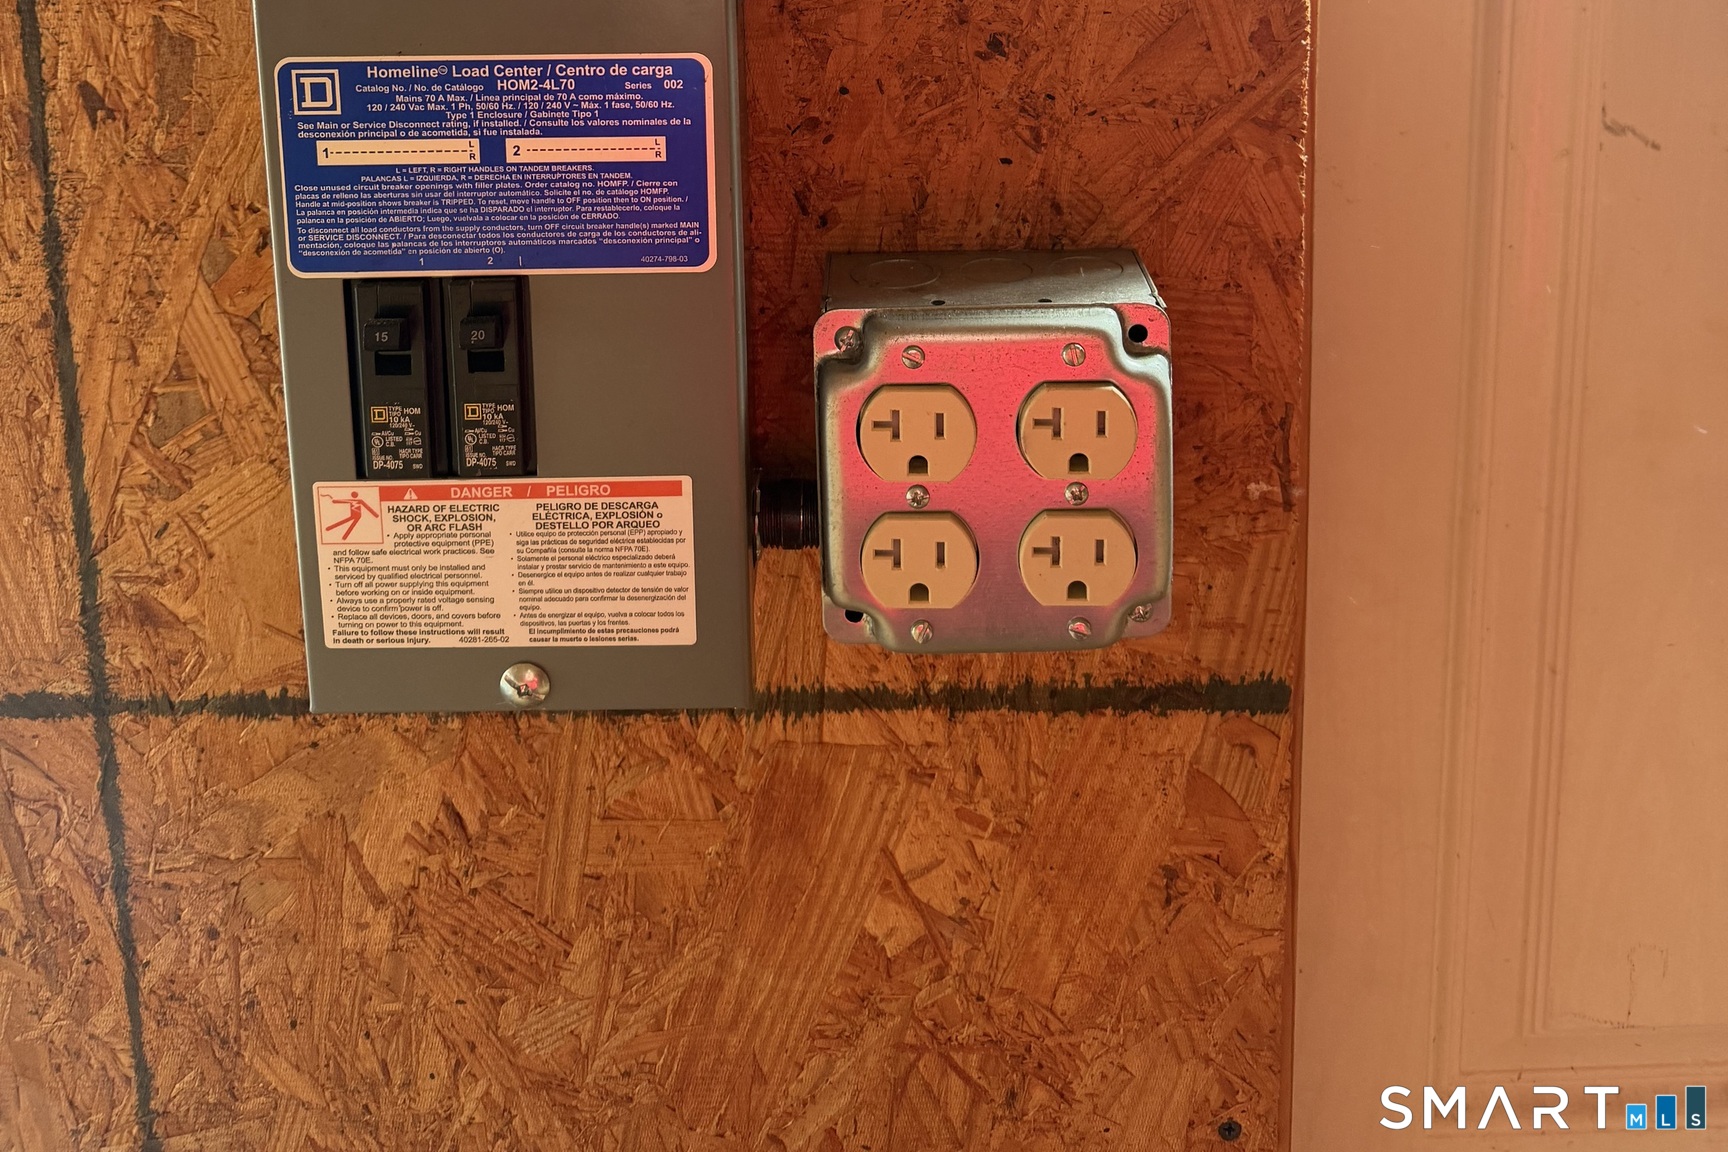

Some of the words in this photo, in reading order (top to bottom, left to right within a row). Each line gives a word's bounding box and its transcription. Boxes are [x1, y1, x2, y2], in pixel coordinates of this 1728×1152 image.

[451, 65, 489, 77] Load
[493, 64, 543, 76] Center
[546, 64, 551, 76] /
[554, 63, 605, 75] Centro
[609, 63, 627, 75] de
[631, 64, 672, 77] carga
[354, 84, 389, 93] Catalog
[391, 83, 407, 91] No.
[408, 83, 412, 91] /
[413, 83, 429, 91] No.
[430, 83, 442, 91] de
[444, 83, 484, 92] Catálogo
[496, 78, 575, 90] HOM2-4L70
[663, 78, 683, 88] 002
[395, 94, 422, 102] Mains
[446, 93, 467, 101] Max.
[470, 93, 473, 101] /
[502, 93, 541, 102] principal
[543, 92, 554, 100] de
[557, 92, 567, 100] 70
[569, 92, 576, 100] A
[605, 91, 642, 99] máximo.
[366, 103, 382, 111] 120
[389, 103, 406, 111] 240
[407, 102, 424, 110] Vac
[426, 102, 448, 110] Max.
[450, 102, 455, 110] 1
[458, 102, 473, 111] Ph,
[475, 102, 499, 110] 50/60
[501, 101, 515, 109] Hz.
[522, 101, 538, 109] 120
[545, 101, 562, 109] 240
[563, 101, 570, 109] V
[580, 100, 601, 108] Máx.
[604, 100, 608, 108] 1
[611, 100, 633, 109] fase,
[634, 100, 658, 108] 50/60
[444, 111, 467, 120] Type
[476, 110, 522, 118] Enclosure
[524, 110, 528, 118] /
[529, 110, 570, 118] Gabinete
[571, 109, 592, 119] Tipo
[593, 109, 599, 117] 1
[297, 121, 314, 129] See
[316, 121, 338, 129] Main
[388, 120, 440, 128] Disconnect
[441, 120, 470, 129] rating,
[472, 119, 479, 127] if
[481, 119, 521, 127] installed.
[528, 118, 568, 126] Consulte
[570, 118, 584, 126] los
[586, 118, 619, 126] valores
[621, 117, 667, 125] nominales
[669, 117, 681, 125] de
[297, 130, 355, 138] desconexión
[358, 129, 397, 139] principal
[421, 128, 470, 137] acometida,
[499, 127, 542, 135] instalada.
[322, 148, 329, 158] 1
[513, 145, 521, 156] 2
[375, 331, 389, 342] 15
[470, 330, 485, 340] 20
[403, 407, 421, 415] HOM
[373, 460, 404, 469] DP-4075
[466, 457, 497, 467] DP-4075
[450, 486, 513, 498] DANGER
[526, 485, 531, 497] /
[546, 484, 610, 496] PELIGRO
[387, 504, 430, 513] HAZARD
[432, 504, 446, 513] OF
[448, 503, 500, 512] ELECTRIC
[535, 502, 582, 511] PELIGRO
[583, 502, 598, 510] DE
[600, 501, 658, 510] DESCARGA
[392, 514, 432, 524] SHOCK,
[434, 513, 497, 523] EXPLOSION,
[532, 510, 592, 521] ELÉCTRICA,
[595, 509, 653, 519] EXPLOSIÓN
[406, 523, 421, 531] OR
[424, 523, 445, 531] ARC
[449, 522, 482, 531] FLASH
[535, 521, 589, 529] DESTELLO
[591, 520, 613, 529] POR
[615, 520, 660, 530] ARQUEO
[332, 628, 358, 636] Failure
[418, 627, 465, 635] instructions
